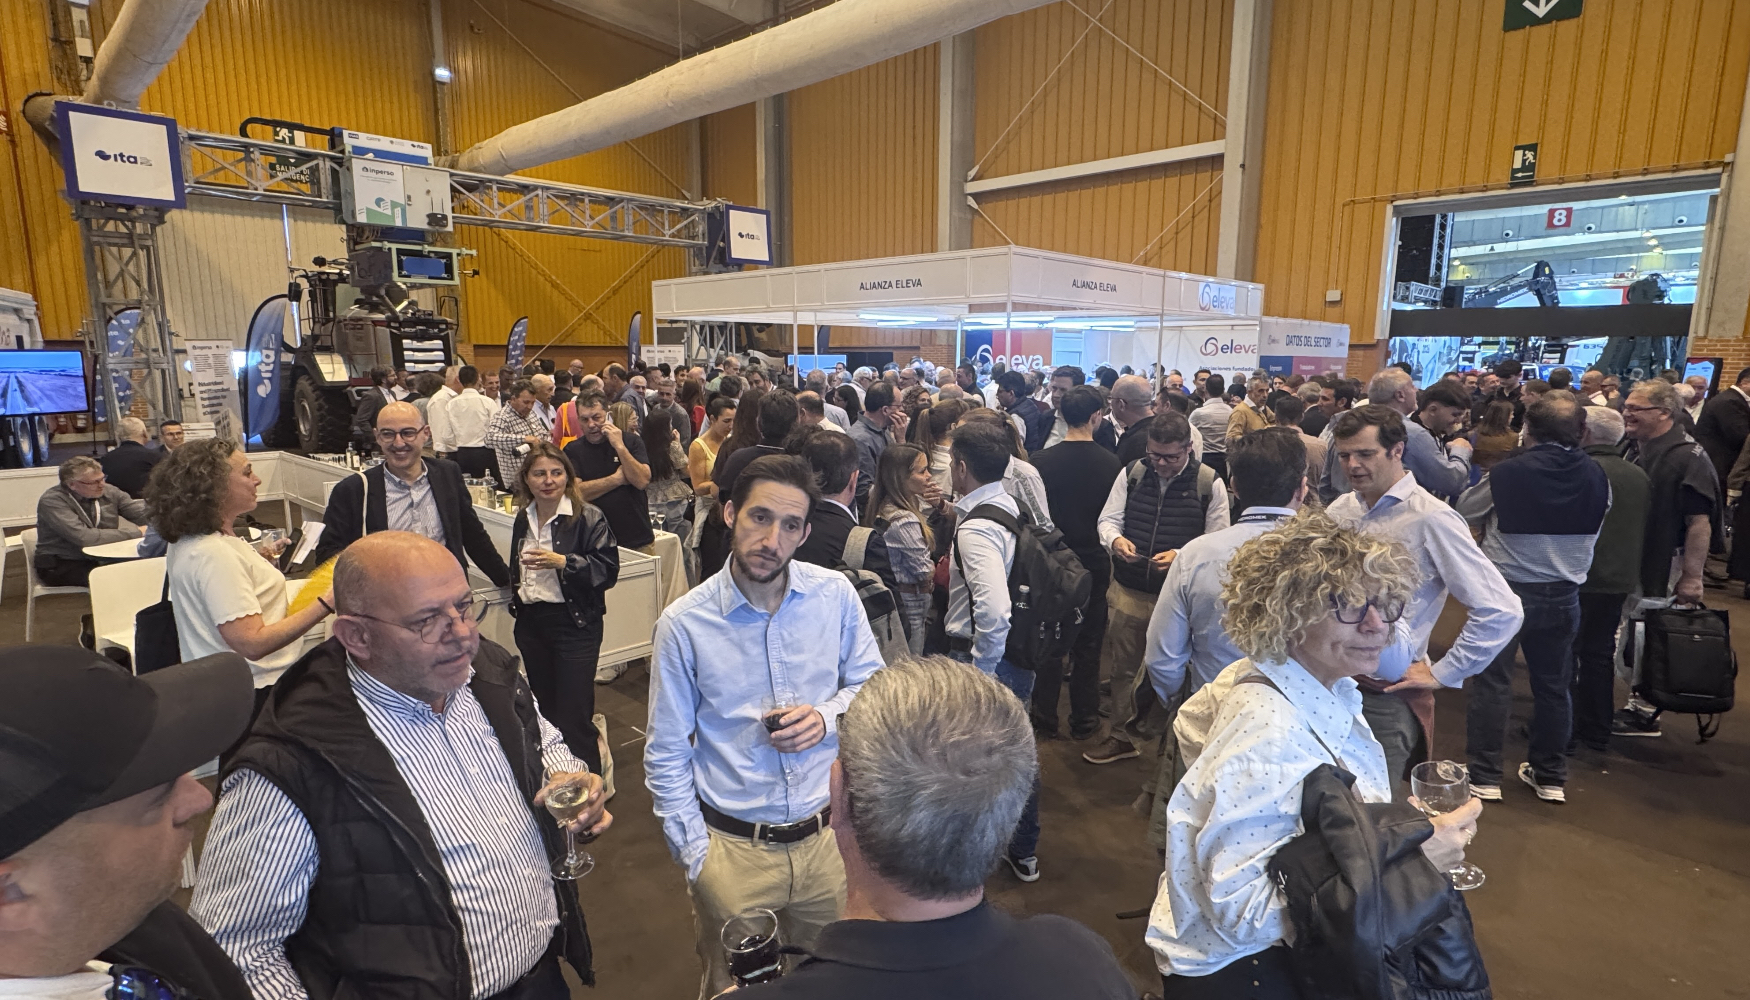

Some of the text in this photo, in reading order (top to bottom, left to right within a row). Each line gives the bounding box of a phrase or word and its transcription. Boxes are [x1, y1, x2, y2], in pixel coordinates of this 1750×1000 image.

[369, 167, 395, 176] inperso
[1552, 209, 1567, 226] 8
[859, 278, 923, 291] ALIANZA ELEVA
[1071, 279, 1118, 293] ALIANZA ELEVA
[1211, 287, 1235, 310] eleva
[1286, 334, 1303, 347] DATOS
[1303, 335, 1313, 347] DEL
[1313, 336, 1332, 348] SECTOR
